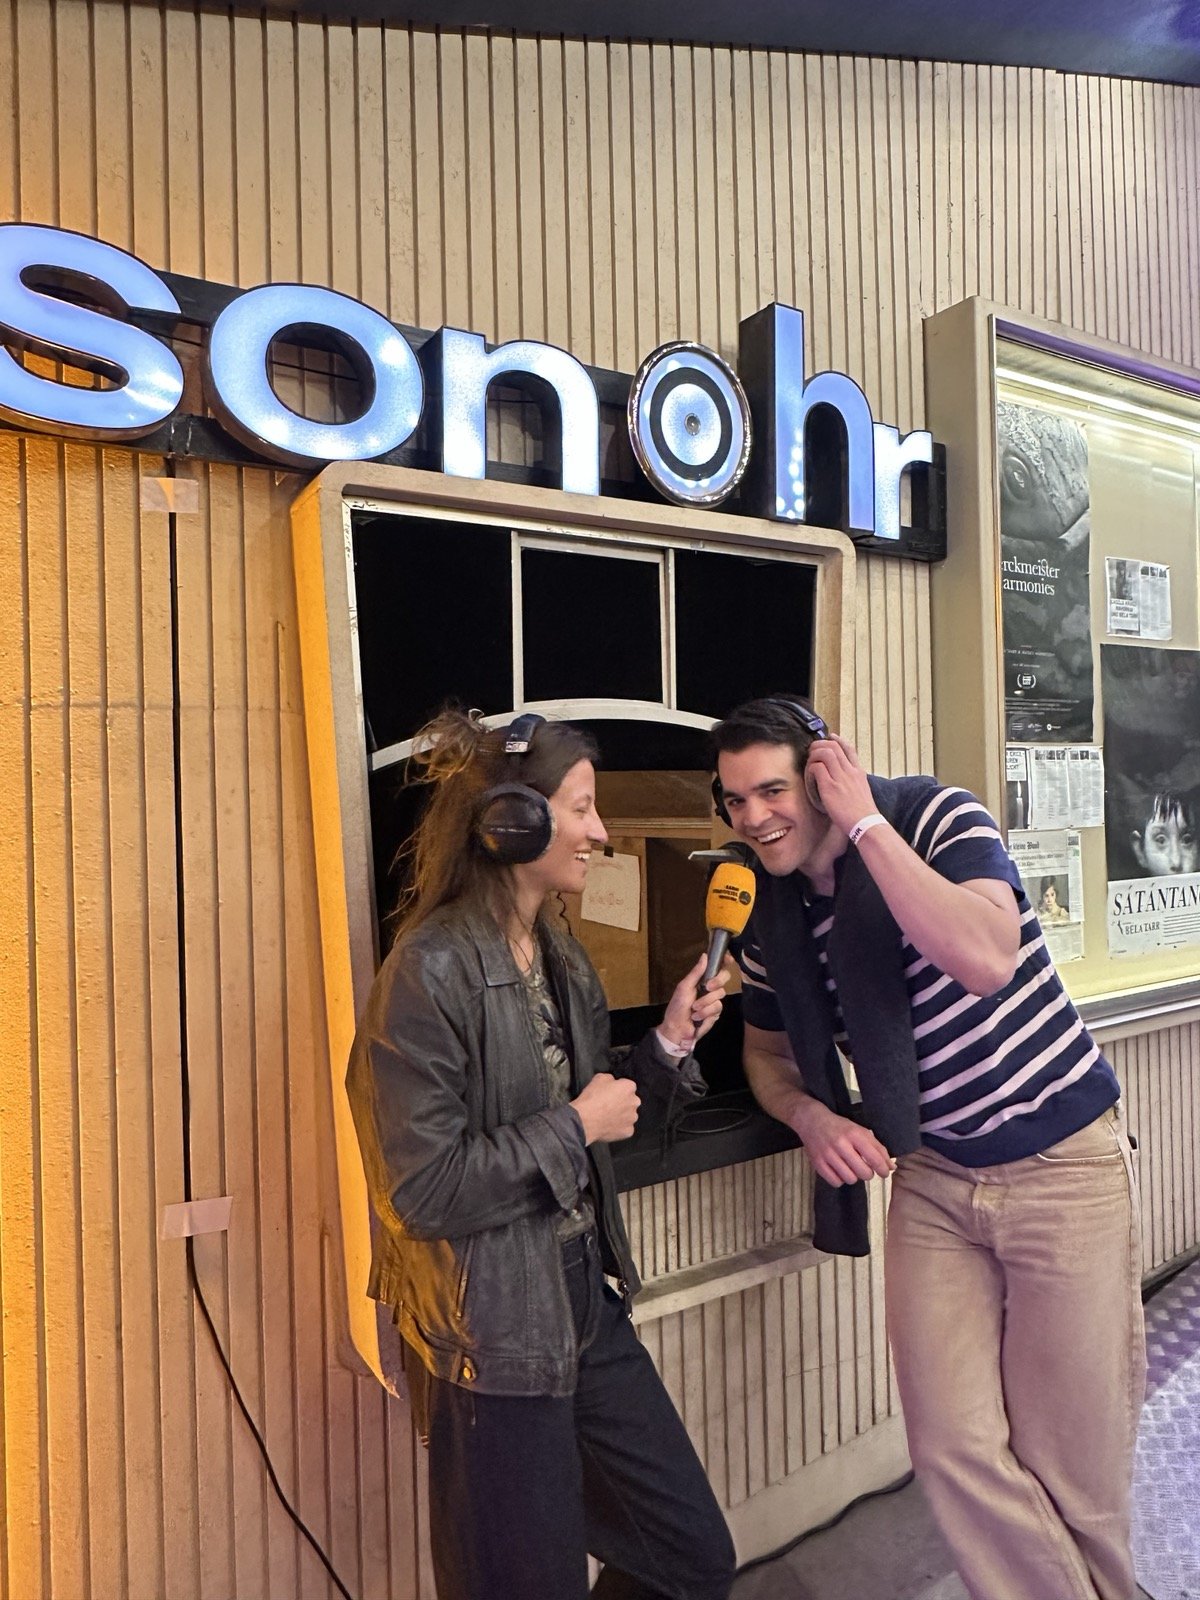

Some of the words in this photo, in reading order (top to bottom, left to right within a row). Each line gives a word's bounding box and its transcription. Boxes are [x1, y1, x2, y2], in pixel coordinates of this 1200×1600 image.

[0, 222, 933, 541] sonohr
[1002, 555, 1060, 579] rckmeister
[1113, 882, 1200, 917] SÁTÁNTAN
